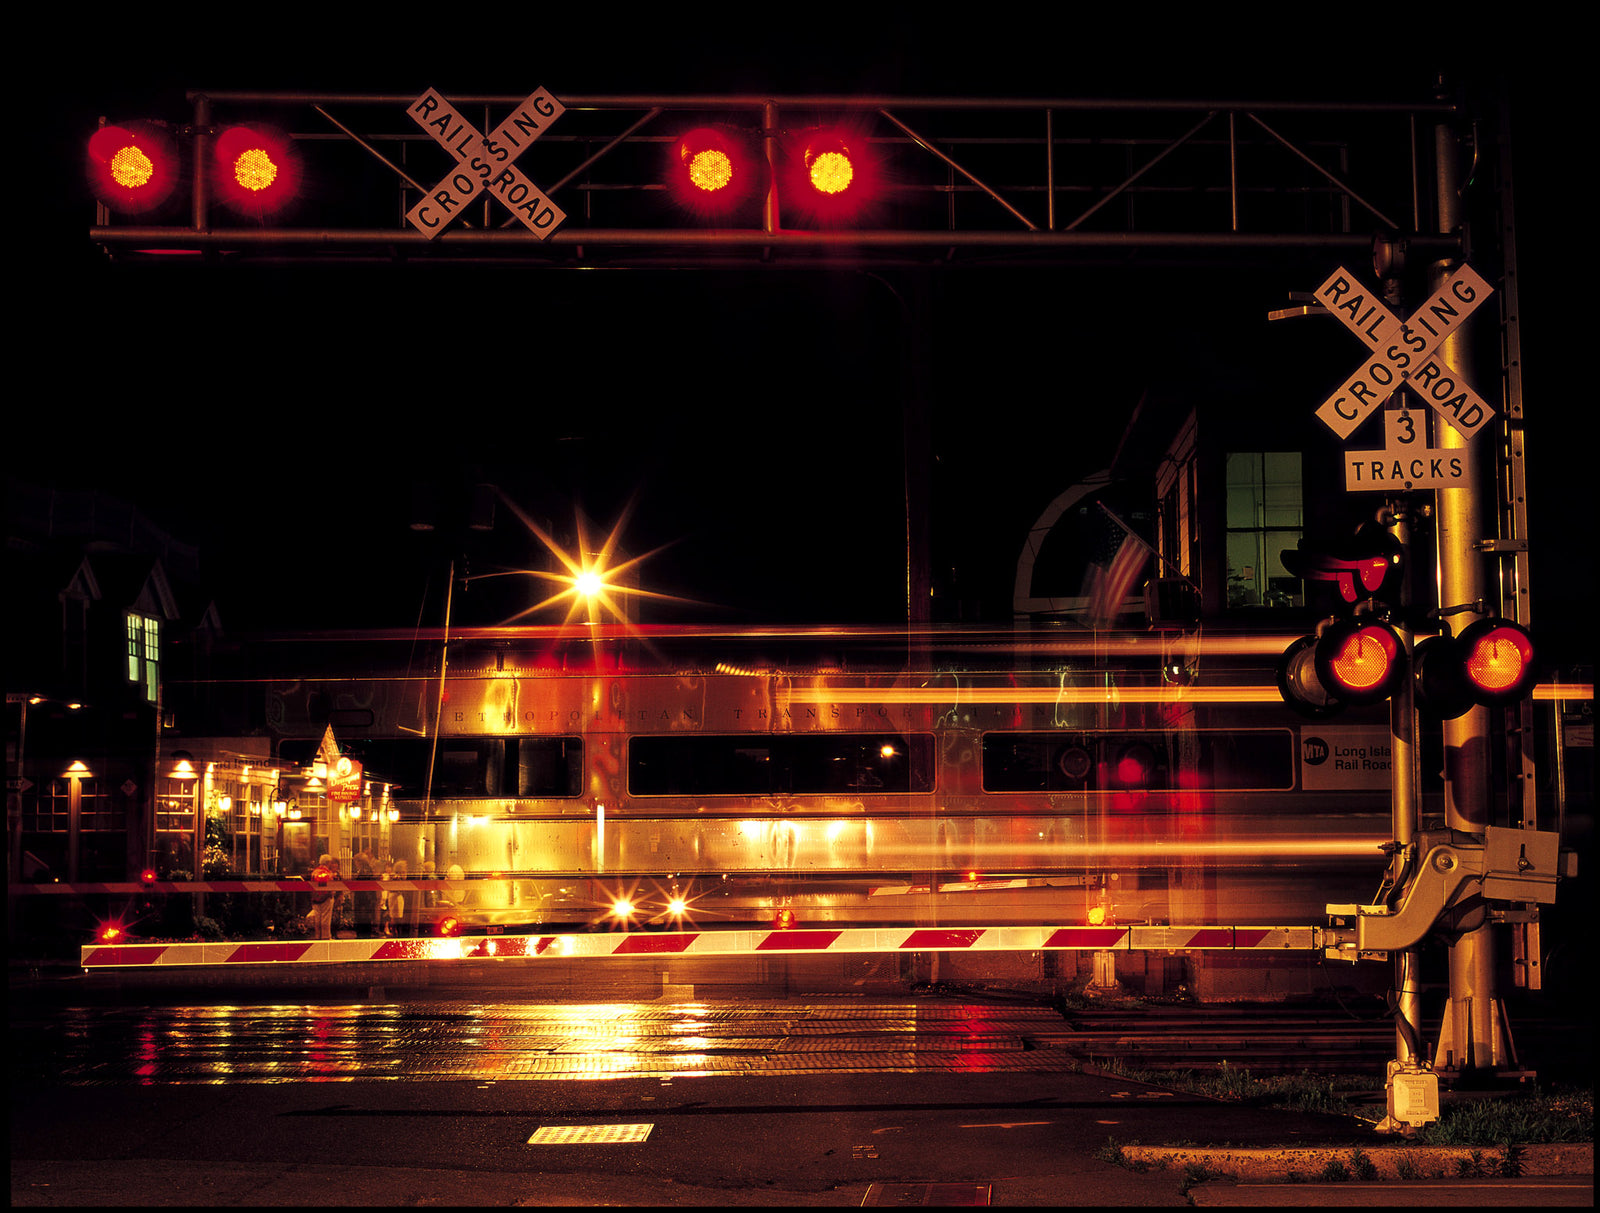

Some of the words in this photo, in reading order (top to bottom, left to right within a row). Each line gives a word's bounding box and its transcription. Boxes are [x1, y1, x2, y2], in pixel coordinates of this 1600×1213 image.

[415, 95, 474, 158] RAIL
[492, 168, 555, 229] ROAD
[418, 96, 555, 228] CROSSING
[1323, 276, 1386, 343] RAIL
[1414, 361, 1484, 428] ROAD
[1333, 280, 1476, 421] CROSSING
[1352, 458, 1462, 481] TRACKS
[1397, 416, 1415, 444] 3
[1334, 746, 1366, 759] Long
[1369, 746, 1391, 757] Isla
[1335, 759, 1359, 770] Rail
